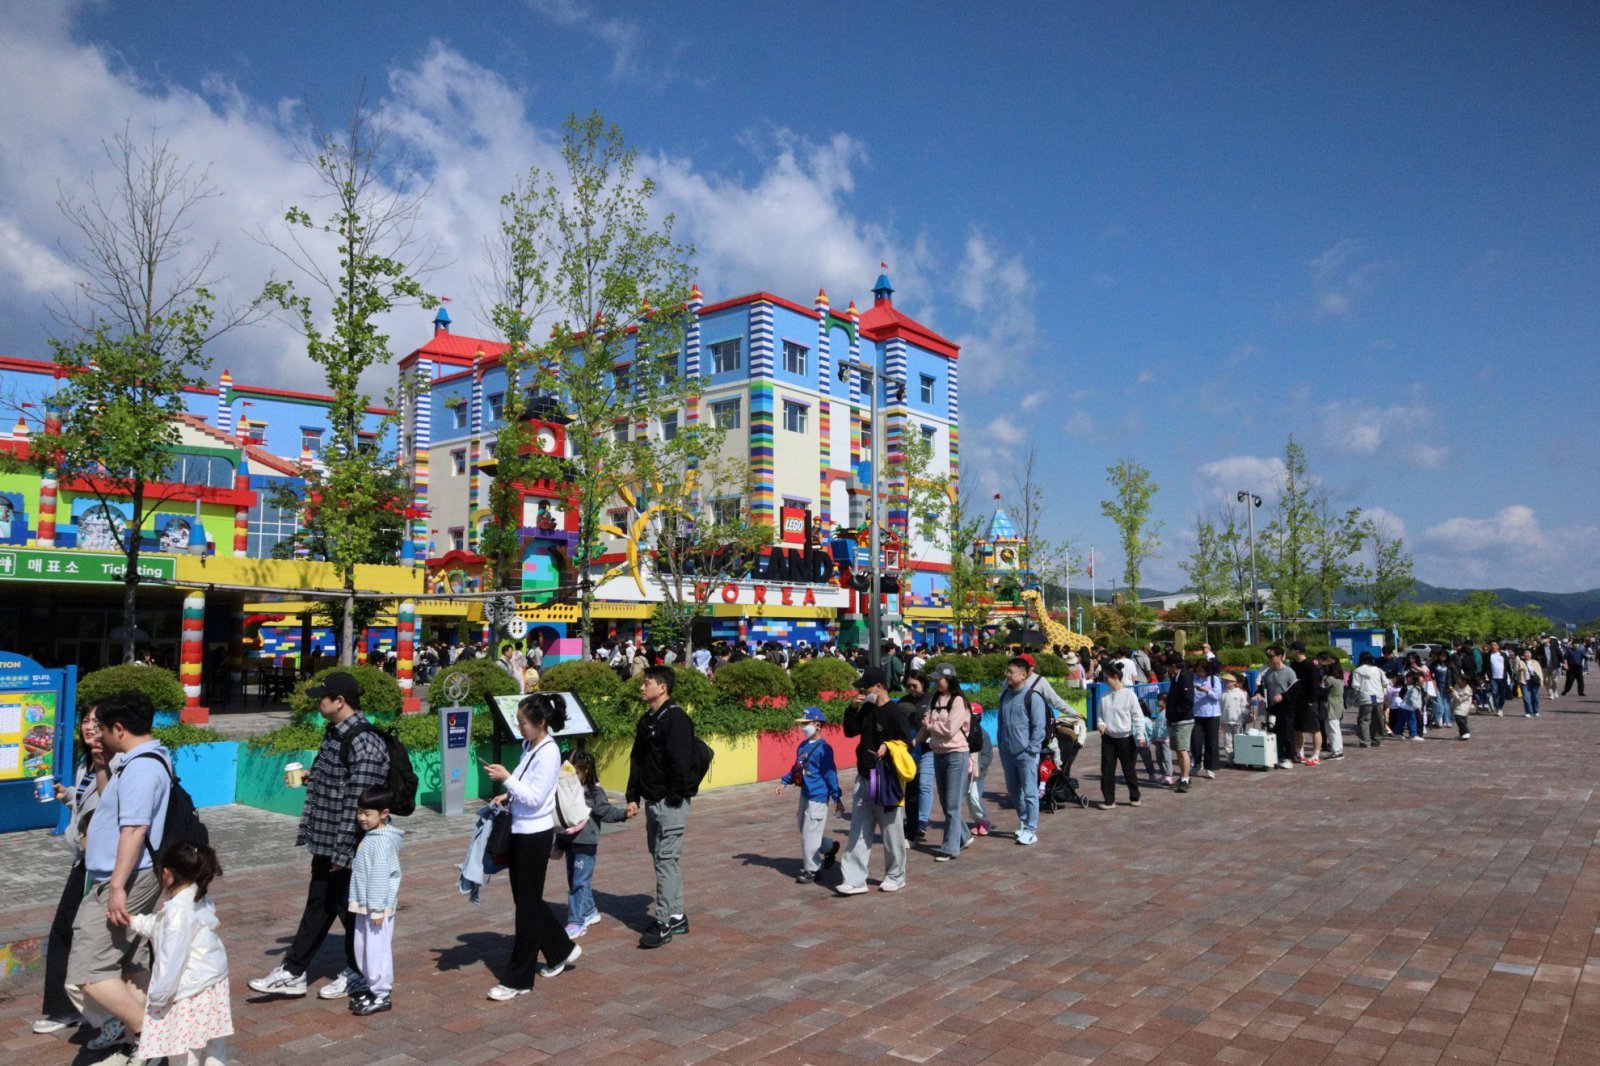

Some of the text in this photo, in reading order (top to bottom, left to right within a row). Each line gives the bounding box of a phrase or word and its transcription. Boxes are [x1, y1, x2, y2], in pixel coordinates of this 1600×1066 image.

[785, 518, 804, 532] LEGO
[28, 558, 80, 573] 매표소
[101, 563, 163, 578] Tickting
